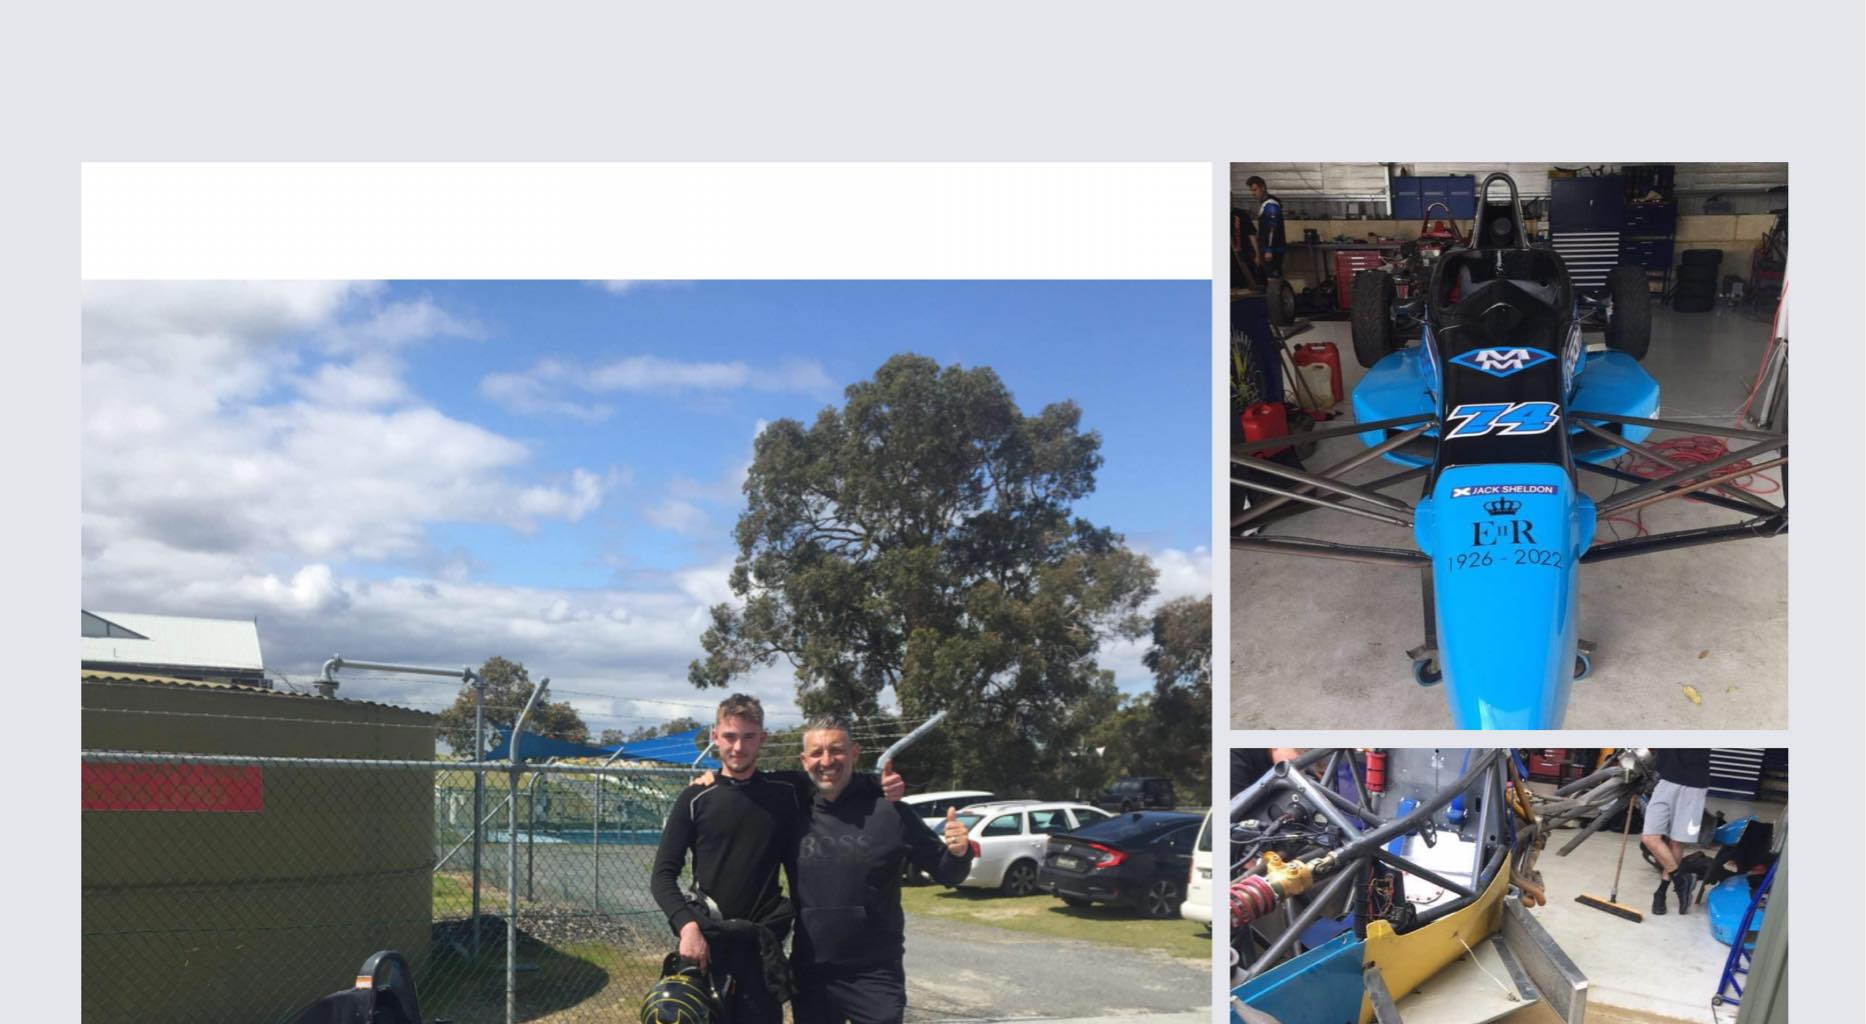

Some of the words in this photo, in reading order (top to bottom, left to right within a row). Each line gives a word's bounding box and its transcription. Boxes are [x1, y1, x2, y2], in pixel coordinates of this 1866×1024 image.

[1445, 401, 1560, 440] 74
[1471, 485, 1500, 495] JACK
[1502, 484, 1554, 494] SHELDON
[1448, 551, 1494, 573] 1926
[1514, 548, 1563, 569] 2022
